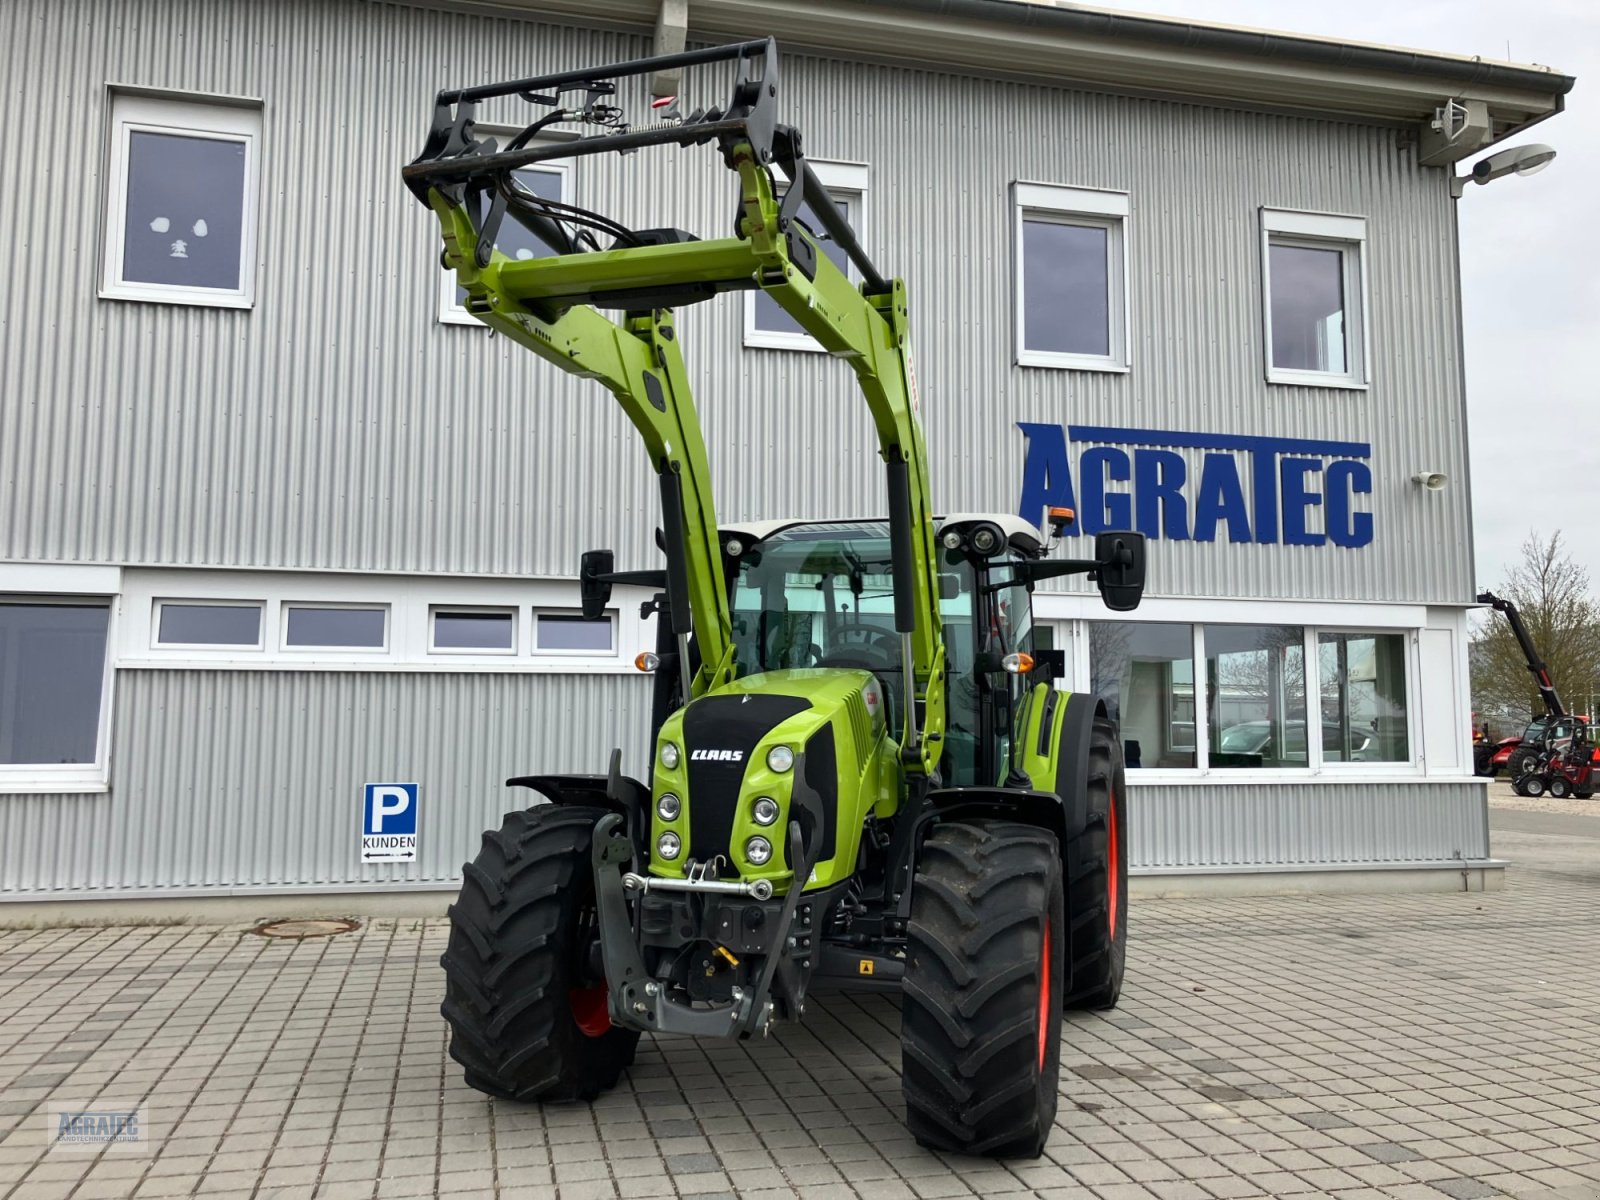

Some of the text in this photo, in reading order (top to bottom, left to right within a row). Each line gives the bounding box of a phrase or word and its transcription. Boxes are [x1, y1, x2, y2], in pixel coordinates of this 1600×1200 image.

[1015, 422, 1374, 548] AGRATEC
[691, 749, 743, 761] CLAAS
[371, 786, 410, 833] P
[363, 837, 416, 848] KUNDEN
